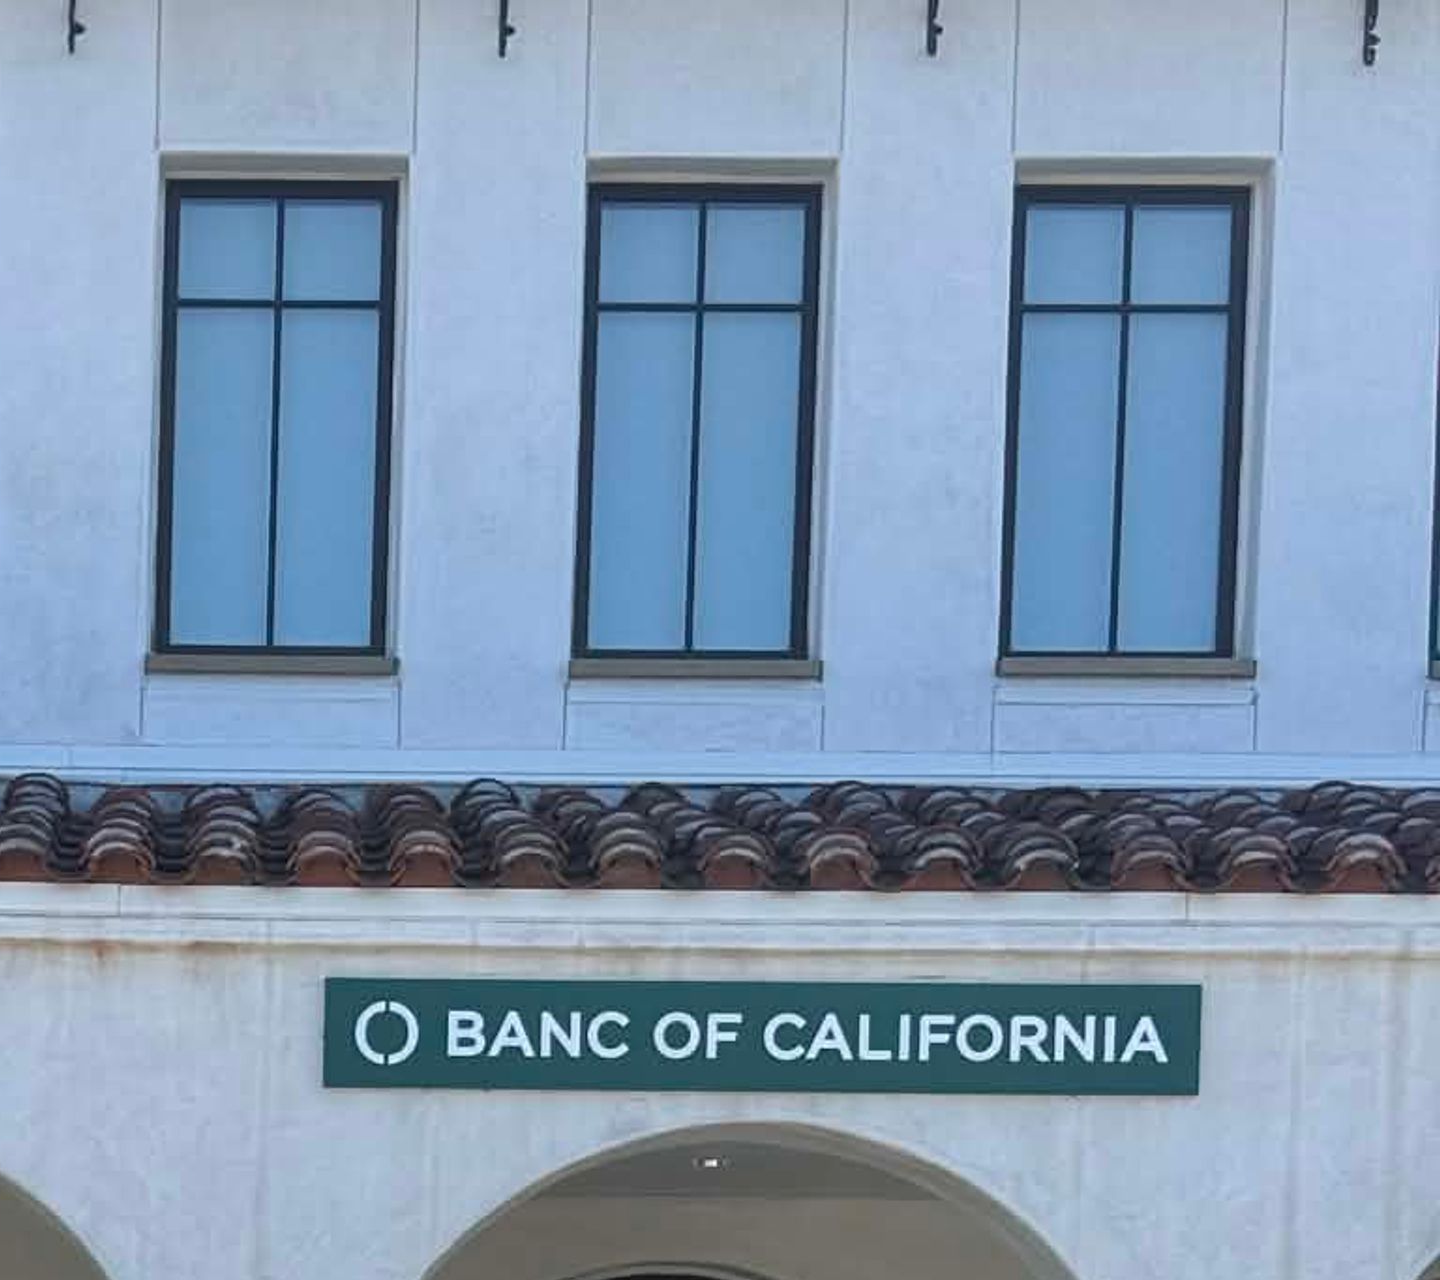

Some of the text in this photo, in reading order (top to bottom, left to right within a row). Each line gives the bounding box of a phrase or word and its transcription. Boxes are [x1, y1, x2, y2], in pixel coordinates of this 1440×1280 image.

[447, 1010, 1168, 1063] BANC OF CALIFORNIA
